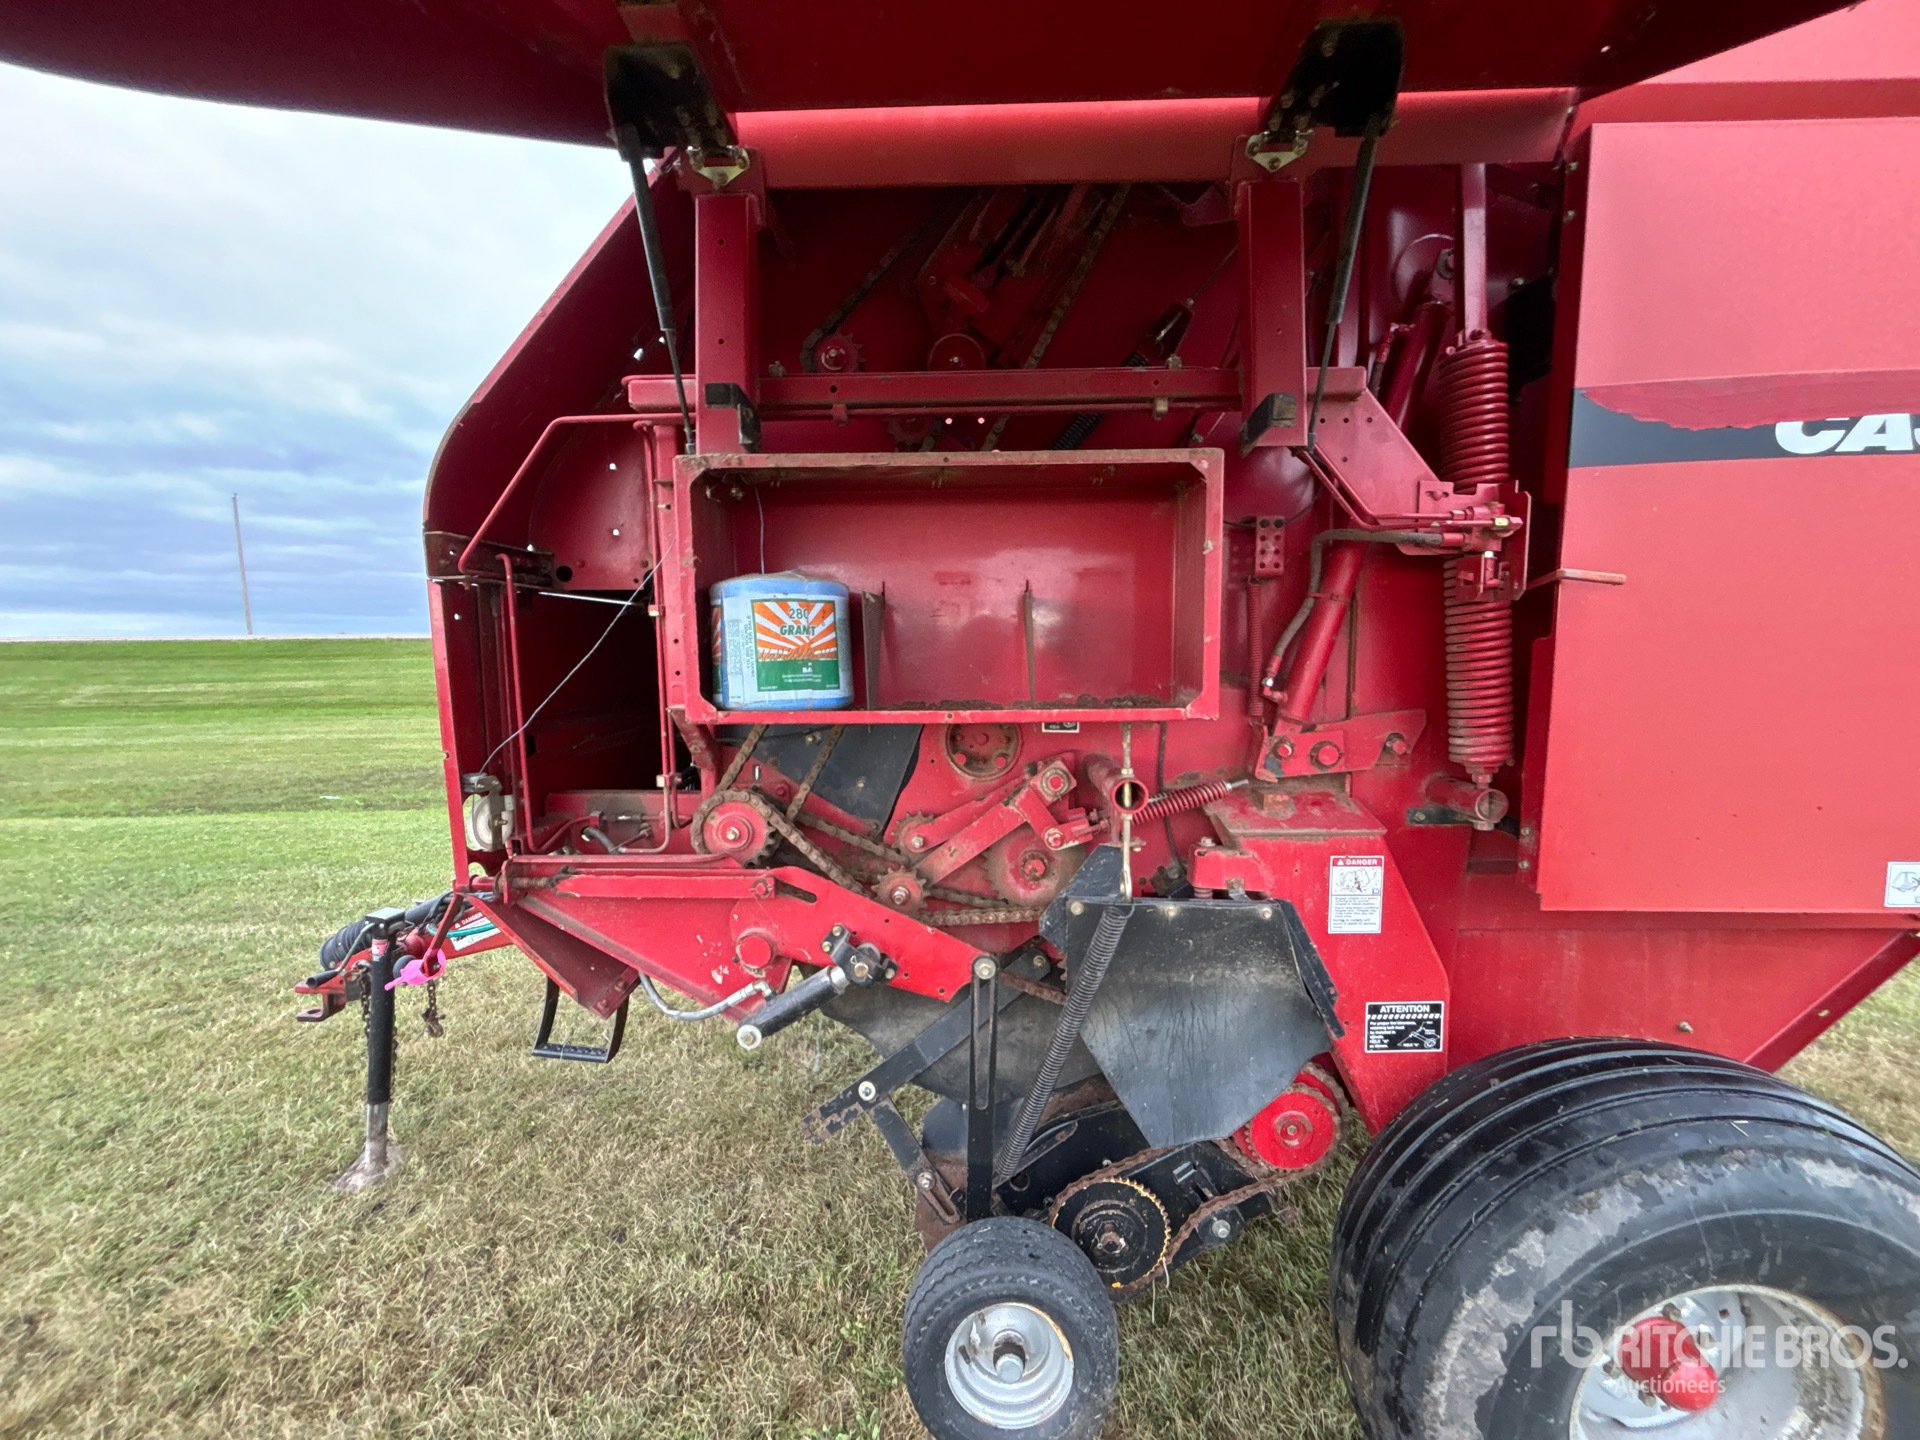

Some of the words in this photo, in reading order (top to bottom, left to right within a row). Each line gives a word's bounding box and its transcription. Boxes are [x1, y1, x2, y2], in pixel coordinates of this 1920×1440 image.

[1775, 413, 1920, 454] CA
[461, 911, 483, 925] DANGER
[1380, 1004, 1430, 1013] ATTENTION
